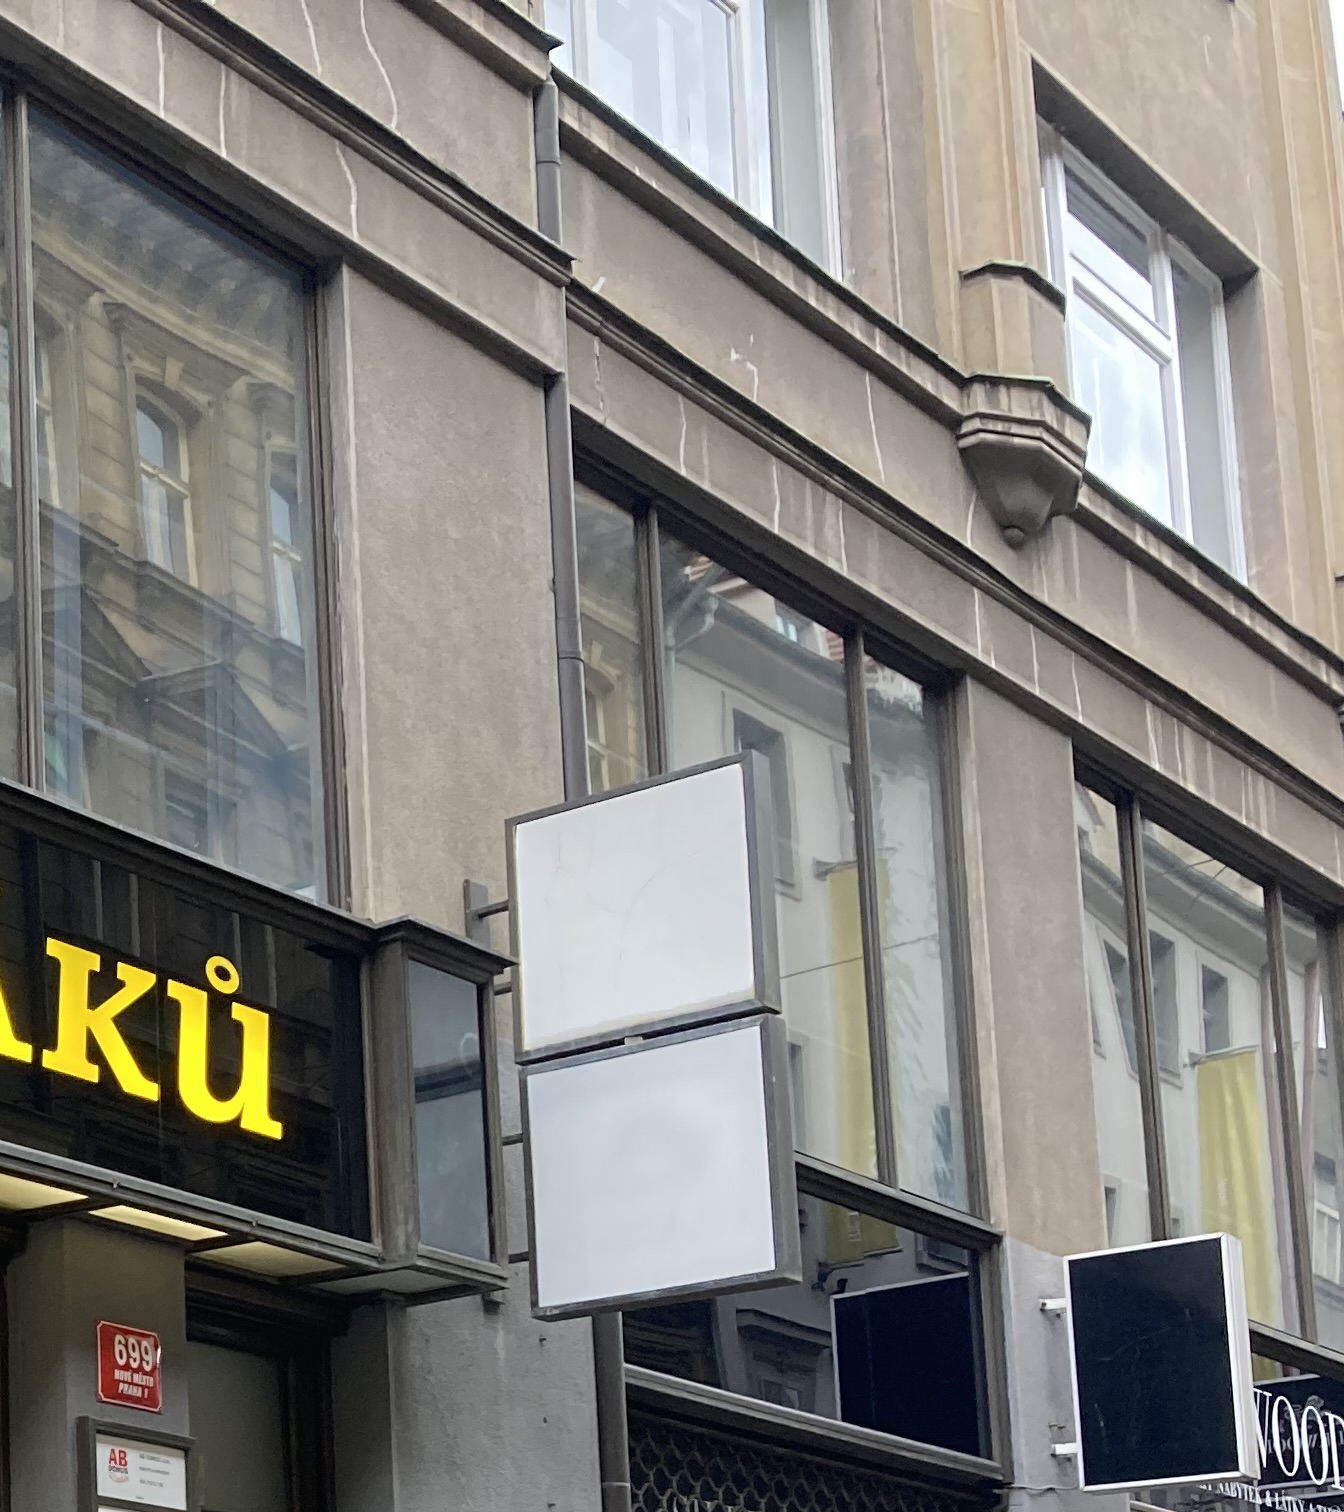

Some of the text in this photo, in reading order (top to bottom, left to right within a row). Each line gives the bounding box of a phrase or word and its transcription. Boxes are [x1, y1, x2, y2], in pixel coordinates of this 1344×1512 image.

[114, 1334, 153, 1372] 699
[114, 1369, 154, 1387] NOVÉ MĚSTO
[118, 1382, 149, 1398] PRAHA 1
[109, 1448, 128, 1467] AB
